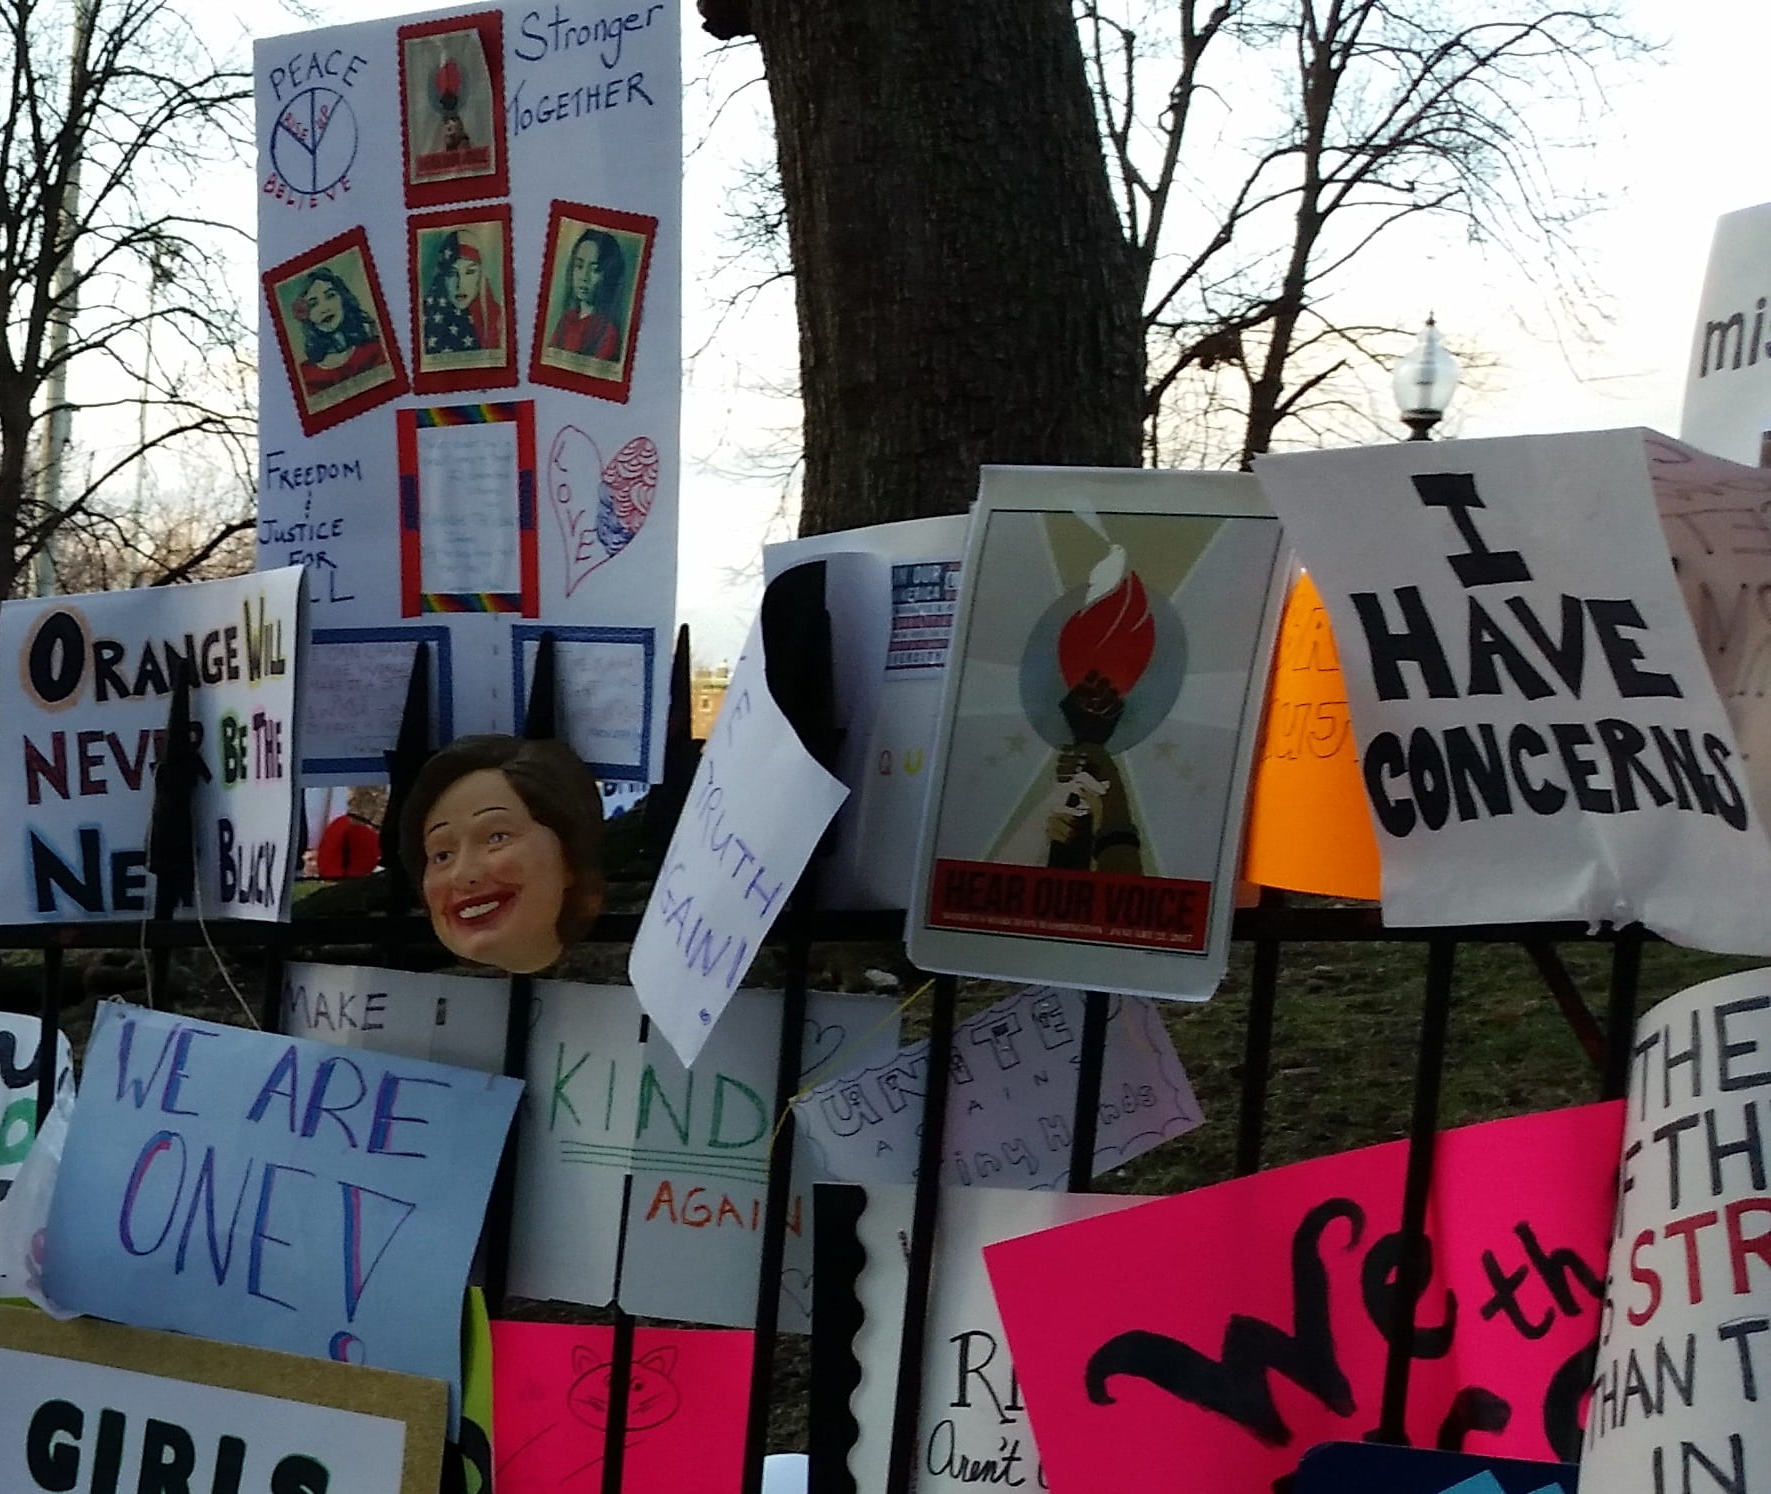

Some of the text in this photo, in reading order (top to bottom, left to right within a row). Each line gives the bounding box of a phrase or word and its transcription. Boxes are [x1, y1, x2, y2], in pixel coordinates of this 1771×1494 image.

[269, 49, 368, 102] PEACE
[262, 172, 351, 212] BELIEVE
[265, 452, 363, 490] FREEDOM
[258, 518, 344, 546] JUSTICE
[1410, 472, 1532, 589] I
[1350, 591, 1683, 702] HAVE
[252, 709, 283, 781] THE
[1362, 721, 1749, 838] CONCERNS
[945, 868, 1027, 910] HEAR
[1033, 873, 1097, 919] OUR
[1104, 884, 1198, 930] VOICE
[114, 1018, 453, 1160] WE ARE
[550, 1041, 771, 1152] KIND
